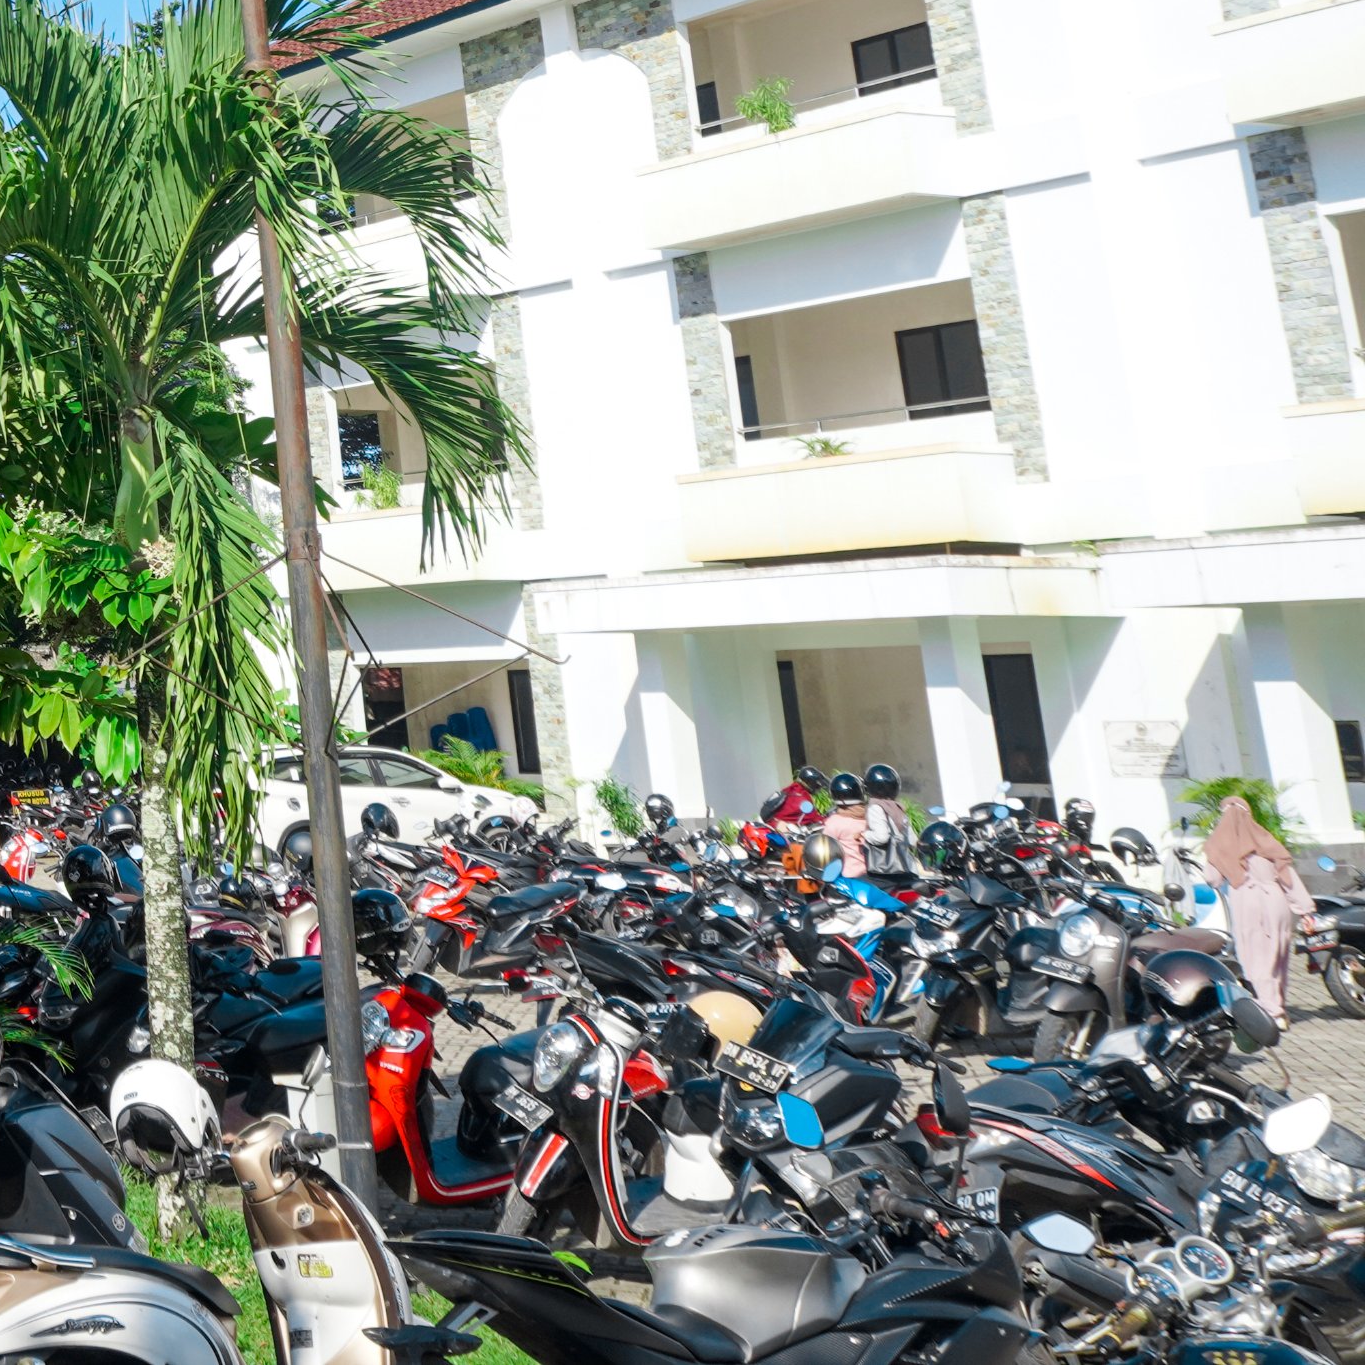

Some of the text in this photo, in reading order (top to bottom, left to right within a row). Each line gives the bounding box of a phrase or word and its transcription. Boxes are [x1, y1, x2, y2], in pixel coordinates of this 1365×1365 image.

[723, 1042, 741, 1059] BN
[771, 1062, 788, 1078] VF
[1221, 1168, 1249, 1193] BN
